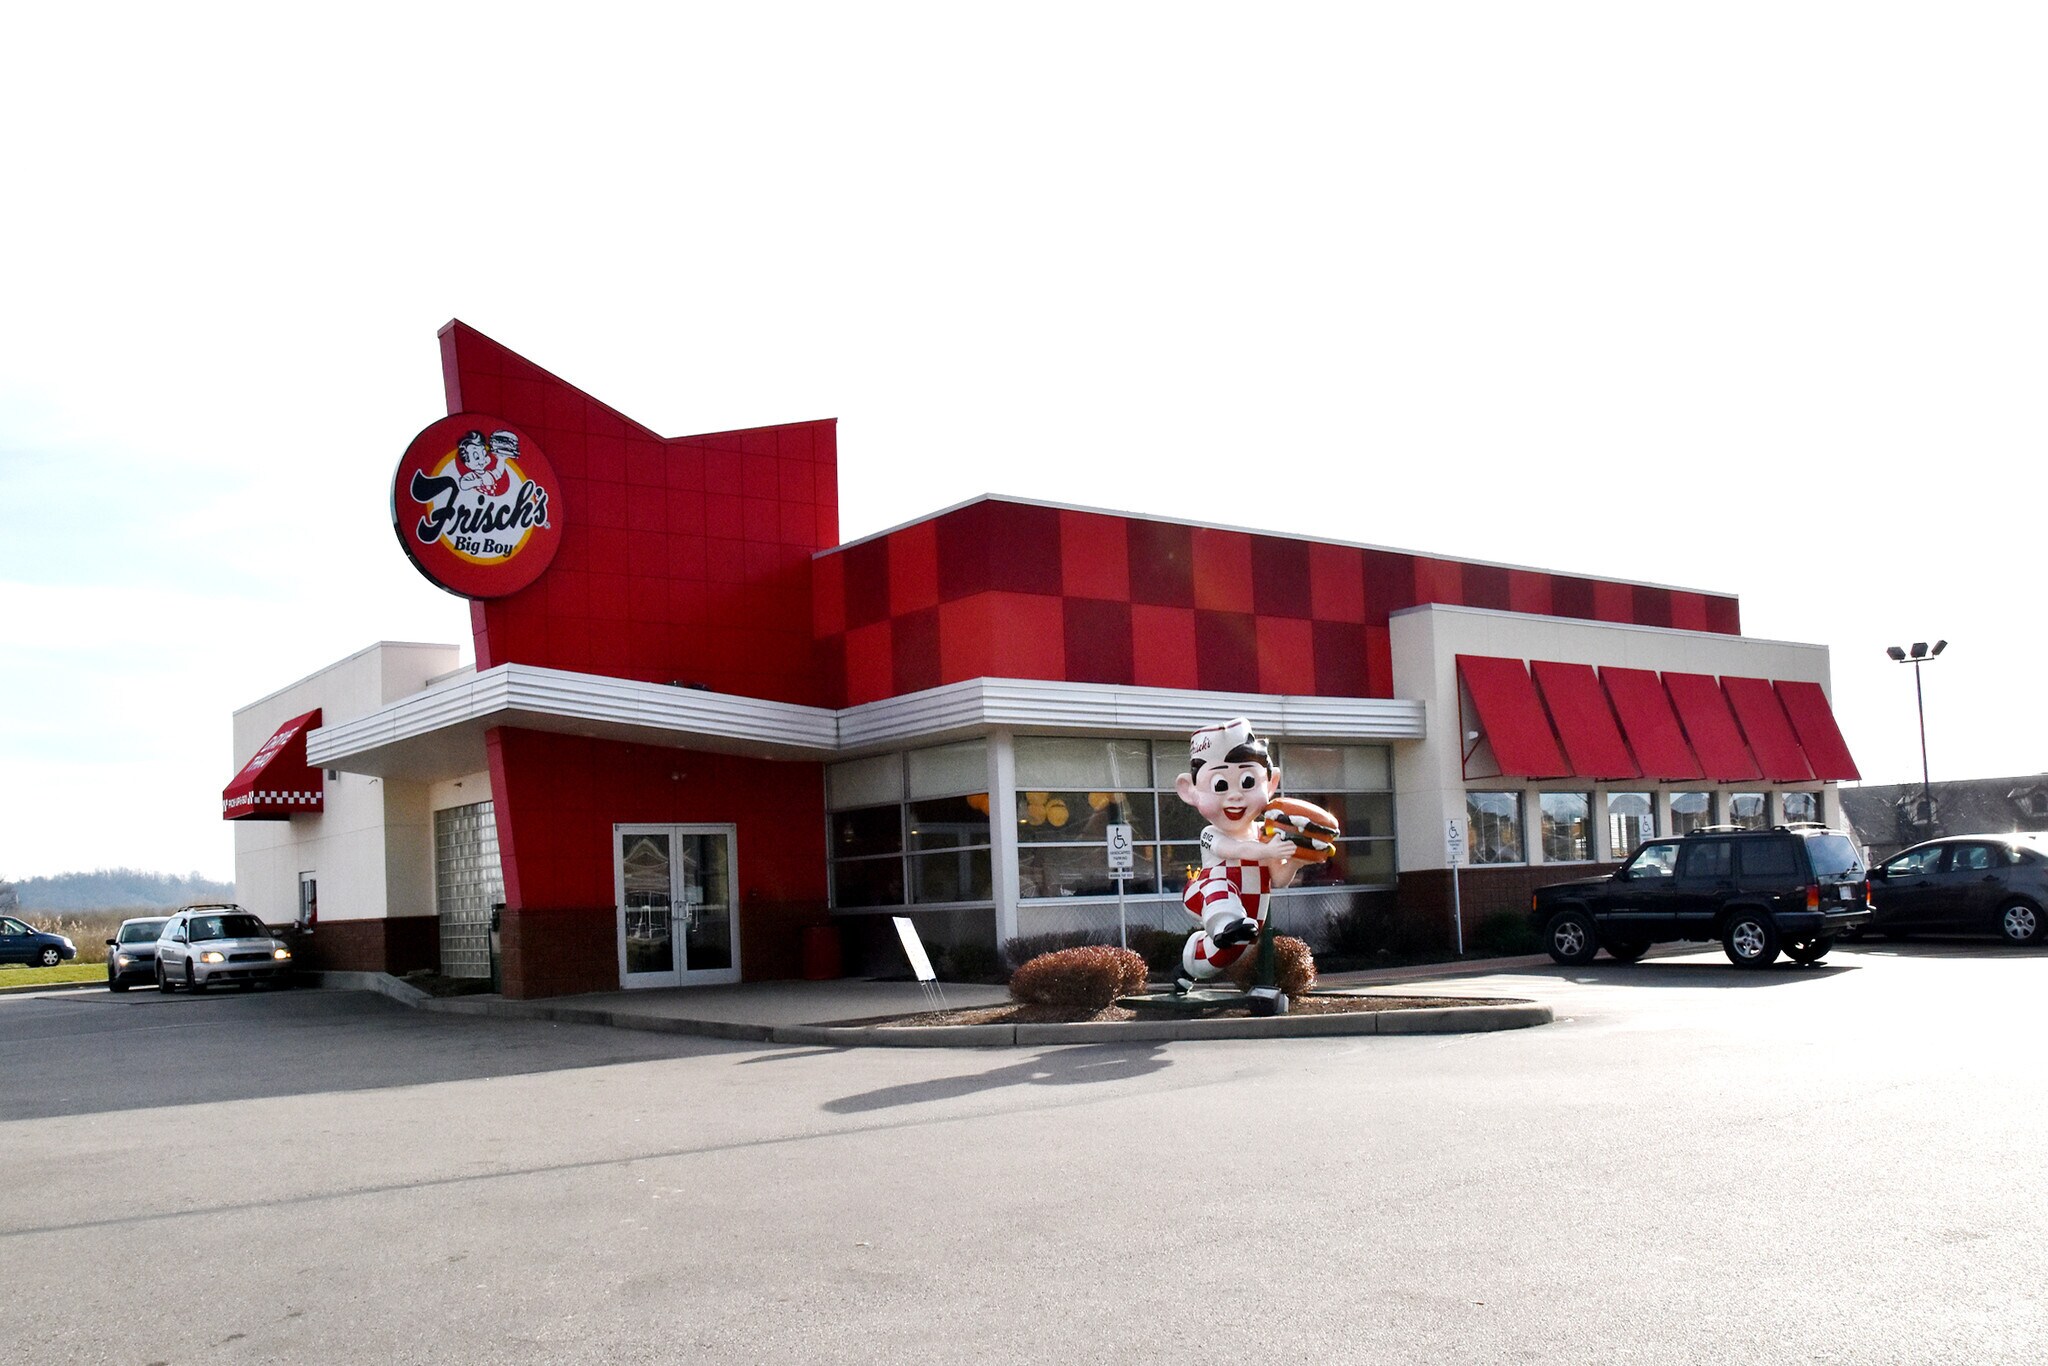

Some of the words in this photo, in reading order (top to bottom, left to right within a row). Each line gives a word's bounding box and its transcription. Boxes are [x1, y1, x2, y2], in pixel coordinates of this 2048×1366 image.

[411, 469, 548, 544] Frisch's
[454, 536, 480, 555] Big
[483, 538, 513, 557] Boy
[1203, 832, 1213, 842] BIG
[1201, 840, 1211, 850] BOY
